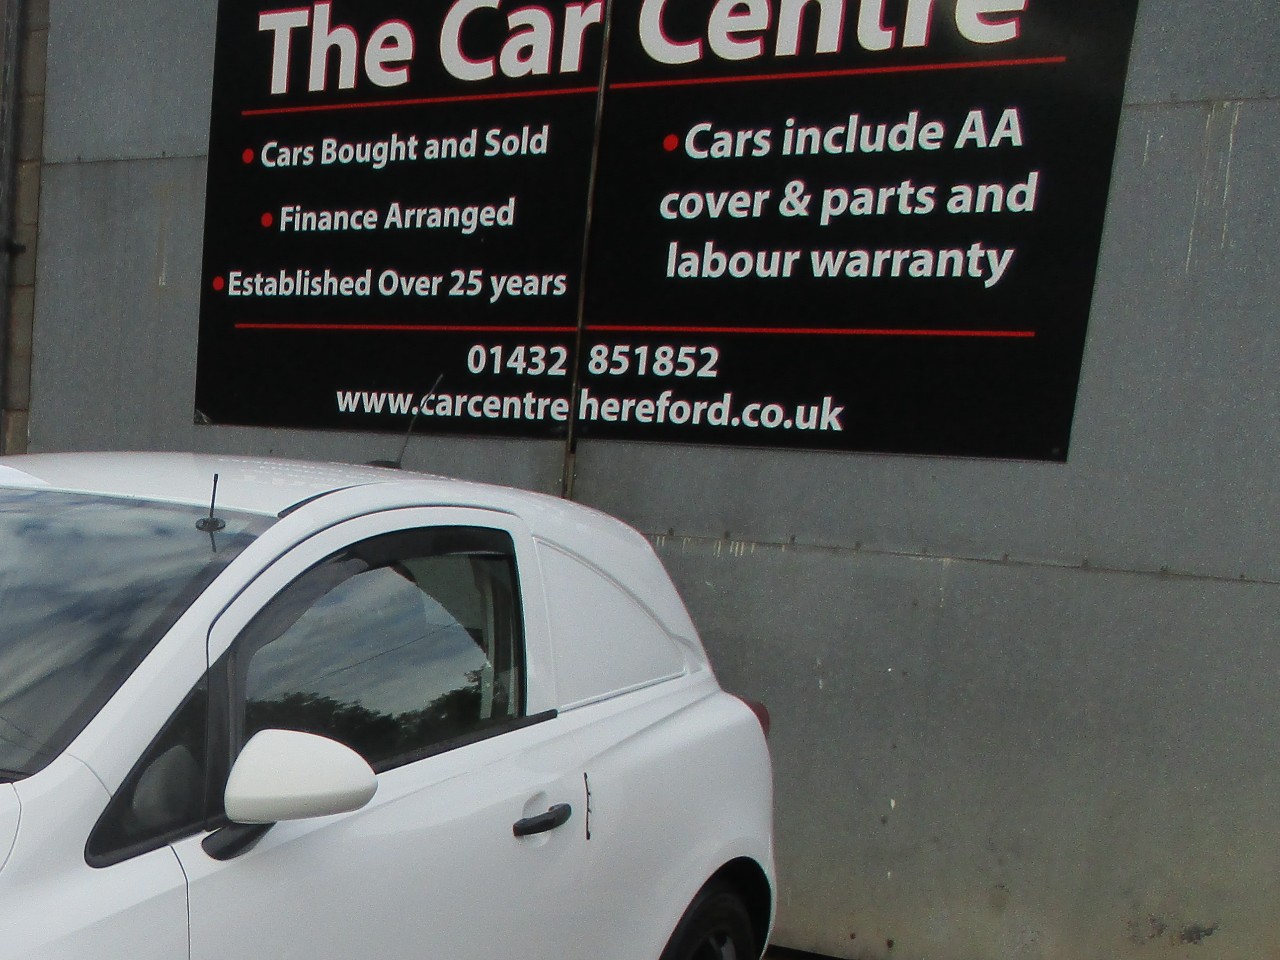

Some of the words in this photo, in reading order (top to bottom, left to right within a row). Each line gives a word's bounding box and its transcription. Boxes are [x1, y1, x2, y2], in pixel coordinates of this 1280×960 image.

[258, 2, 414, 94] The
[439, 0, 602, 82] Car
[638, 0, 1026, 64] Centre
[261, 142, 314, 167] Cars
[320, 133, 418, 169] Bought
[424, 129, 478, 159] and
[484, 125, 549, 156] Sold
[684, 123, 771, 159] Cars
[782, 112, 945, 156] include
[954, 109, 1023, 149] AA
[279, 205, 378, 232] Finance
[383, 197, 516, 235] Arranged
[659, 188, 770, 219] cover
[778, 180, 812, 217] &
[819, 180, 937, 225] parts
[946, 172, 1039, 214] and
[228, 269, 372, 296] Established
[378, 270, 443, 296] Over
[448, 269, 483, 296] 25
[489, 273, 567, 304] years
[666, 241, 801, 278] labour
[810, 242, 1015, 288] warranty
[467, 344, 568, 376] 01432
[587, 344, 720, 378] 851852
